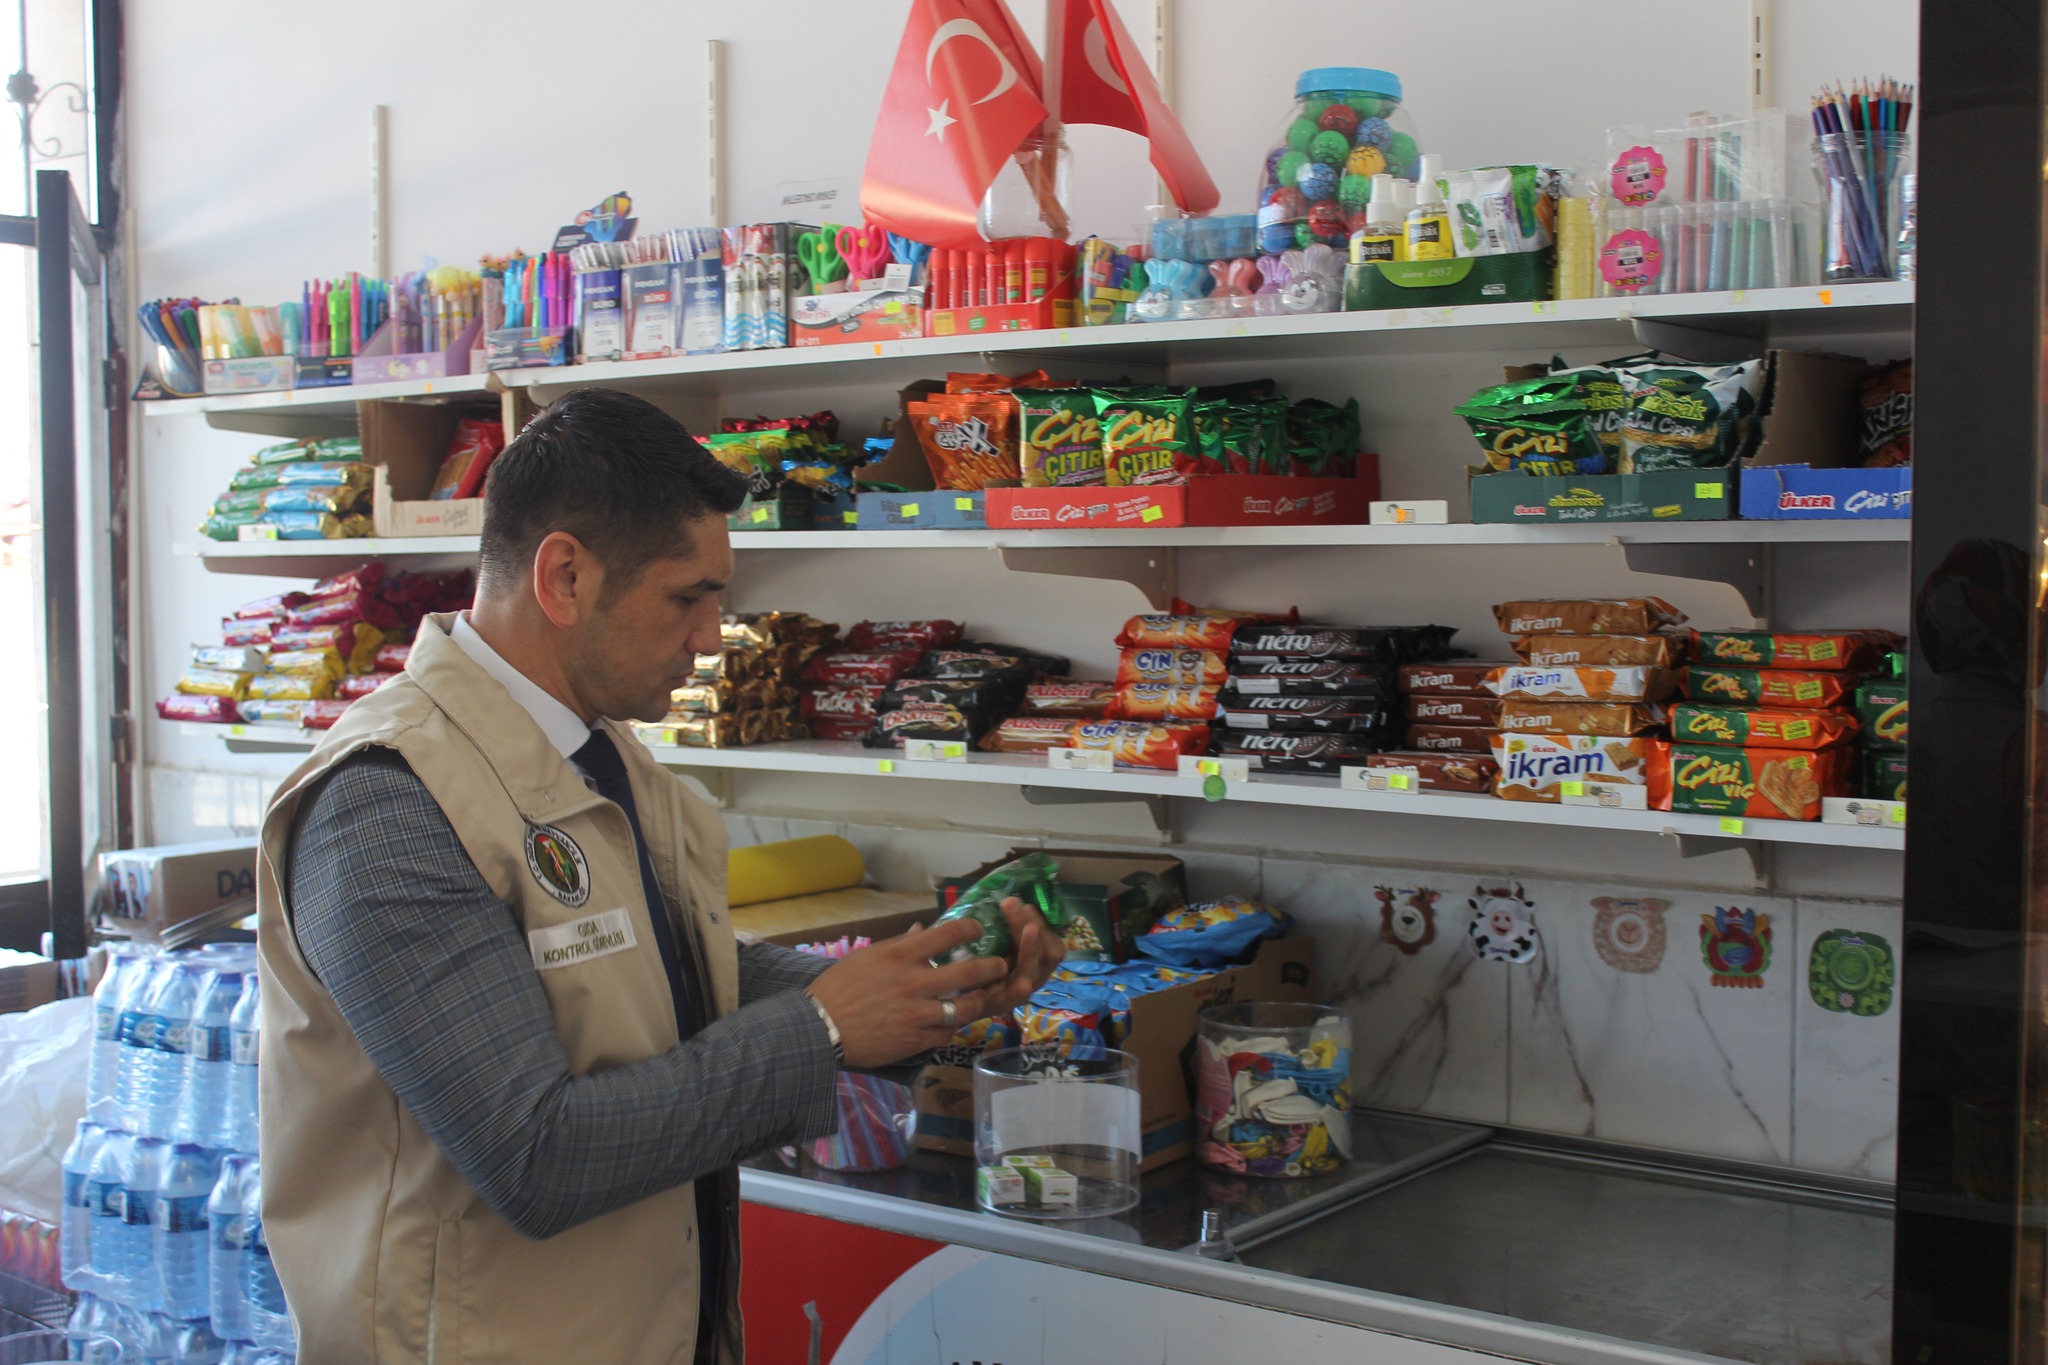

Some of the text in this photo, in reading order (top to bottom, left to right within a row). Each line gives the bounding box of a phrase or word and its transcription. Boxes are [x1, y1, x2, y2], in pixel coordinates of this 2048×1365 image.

[1030, 409, 1100, 451] Çiz
[1108, 410, 1176, 451] Çizi
[1493, 427, 1568, 458] Çizi
[1118, 450, 1173, 485] ÇITIR
[1778, 491, 1836, 510] ÜLKER
[1843, 489, 1889, 513] Çizi
[1510, 616, 1562, 633] ikram
[1257, 634, 1313, 651] nero
[1260, 663, 1320, 674] nero
[1410, 673, 1454, 688] ikram
[1510, 672, 1562, 689] ikram
[1249, 697, 1310, 710] nero
[1417, 703, 1463, 717] ikram
[1503, 714, 1552, 729] ikram
[1240, 735, 1301, 751] nero
[1417, 737, 1463, 749] ikram
[1508, 751, 1604, 779] ikram
[1676, 755, 1742, 790] Çizi
[577, 919, 600, 937] GIDA
[543, 941, 594, 965] KONTROL
